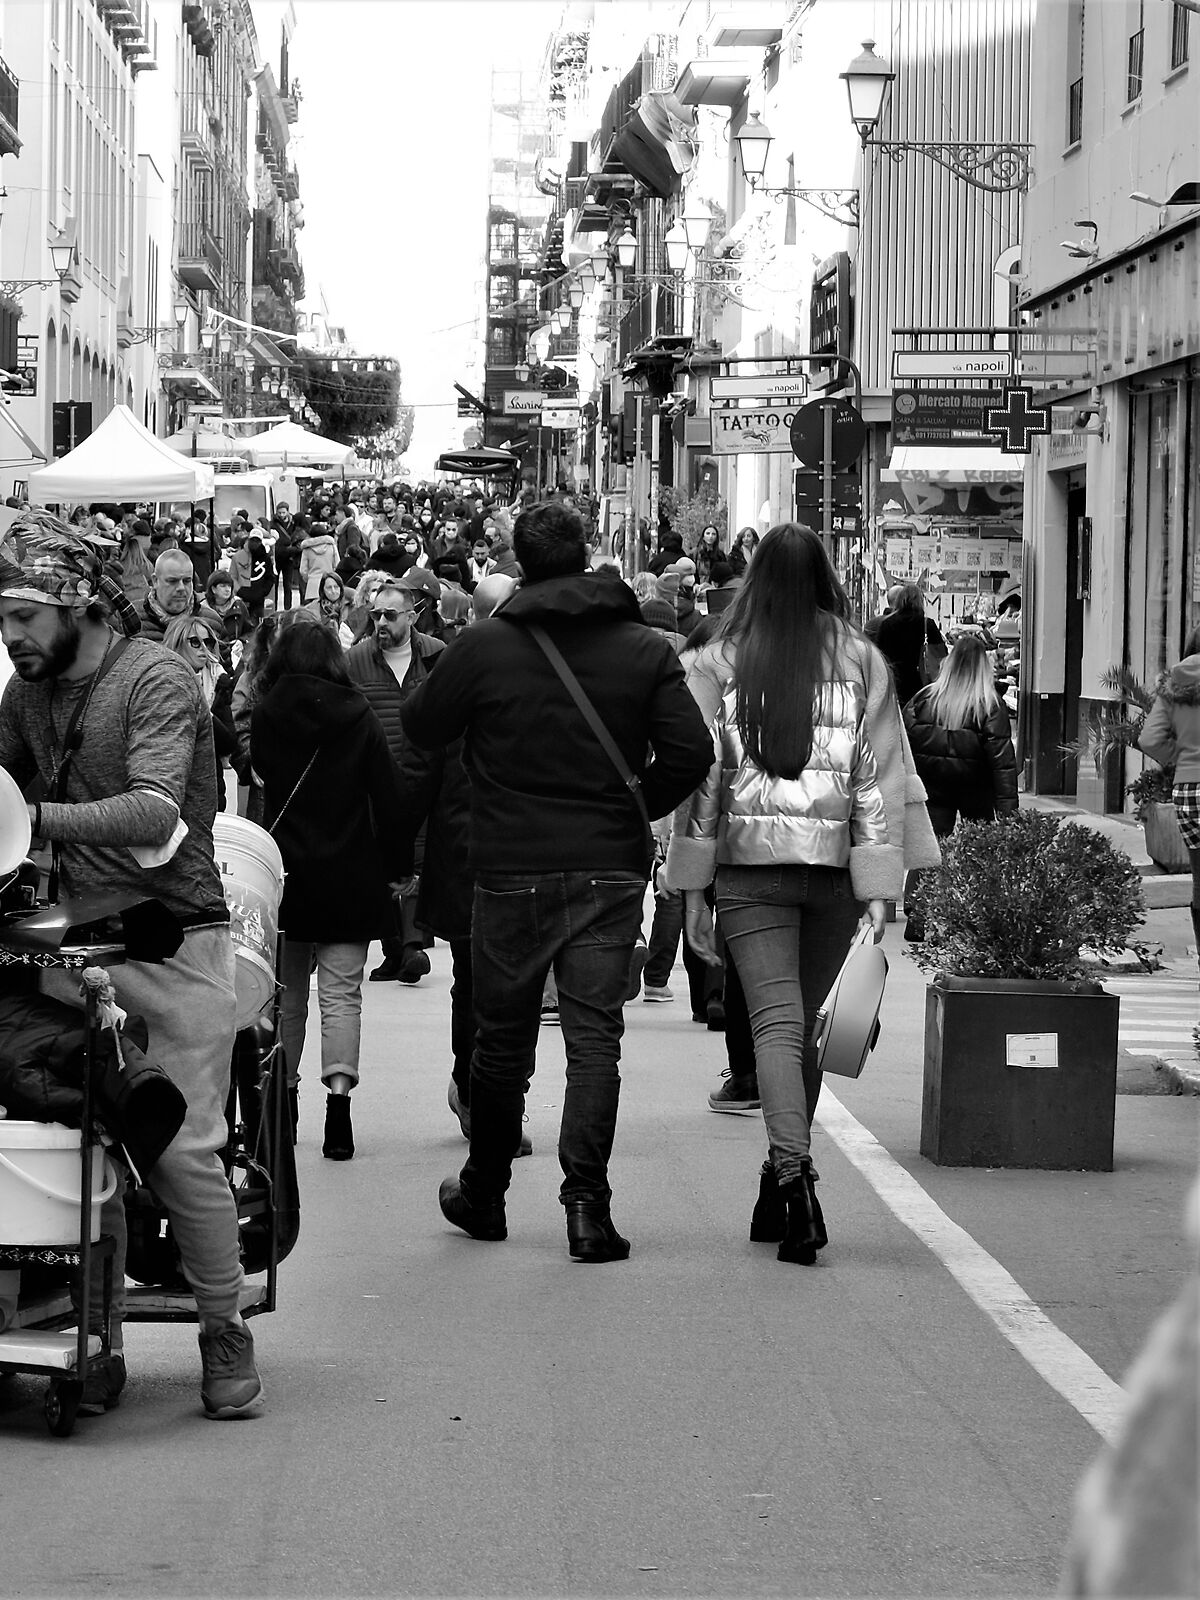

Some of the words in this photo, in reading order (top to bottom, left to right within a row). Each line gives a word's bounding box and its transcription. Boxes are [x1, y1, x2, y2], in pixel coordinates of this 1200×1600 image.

[965, 360, 1005, 372] napoli
[774, 383, 800, 392] napoli
[919, 395, 960, 407] Mercato
[963, 395, 1004, 408] Maqued
[719, 412, 796, 431] TATTOO
